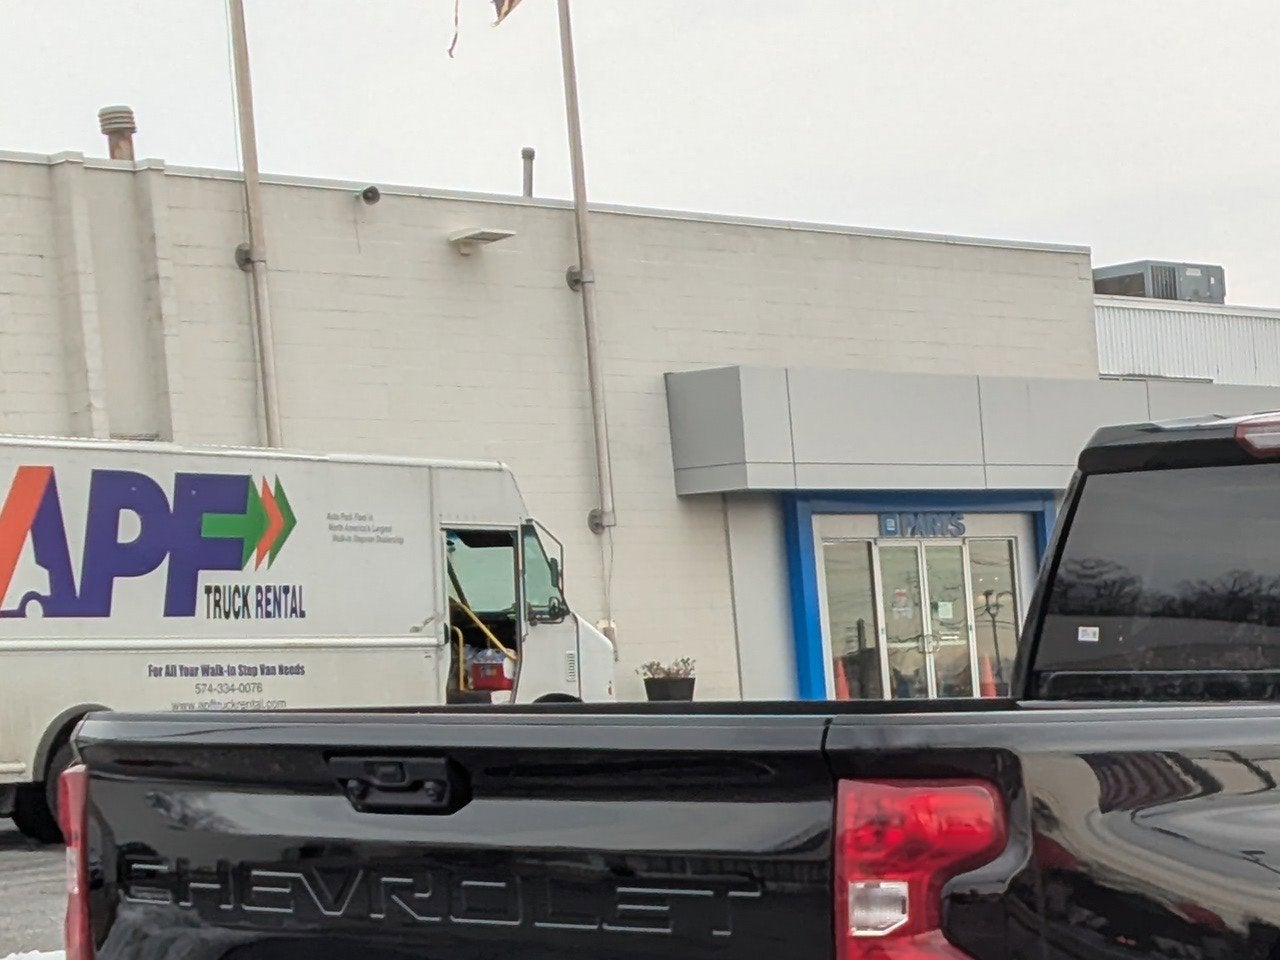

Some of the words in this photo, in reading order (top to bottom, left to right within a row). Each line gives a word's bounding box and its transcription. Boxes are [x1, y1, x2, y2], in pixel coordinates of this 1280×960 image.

[0, 465, 252, 618] APF
[901, 512, 966, 538] PARTS
[204, 584, 252, 620] TRUCK
[255, 584, 306, 619] RENTAL
[148, 664, 163, 677] For
[165, 664, 177, 677] All
[179, 664, 199, 677] Your
[238, 664, 258, 678] Step
[260, 663, 276, 676] Van
[278, 663, 305, 676] Needs
[118, 857, 763, 937] CHEVROLET
